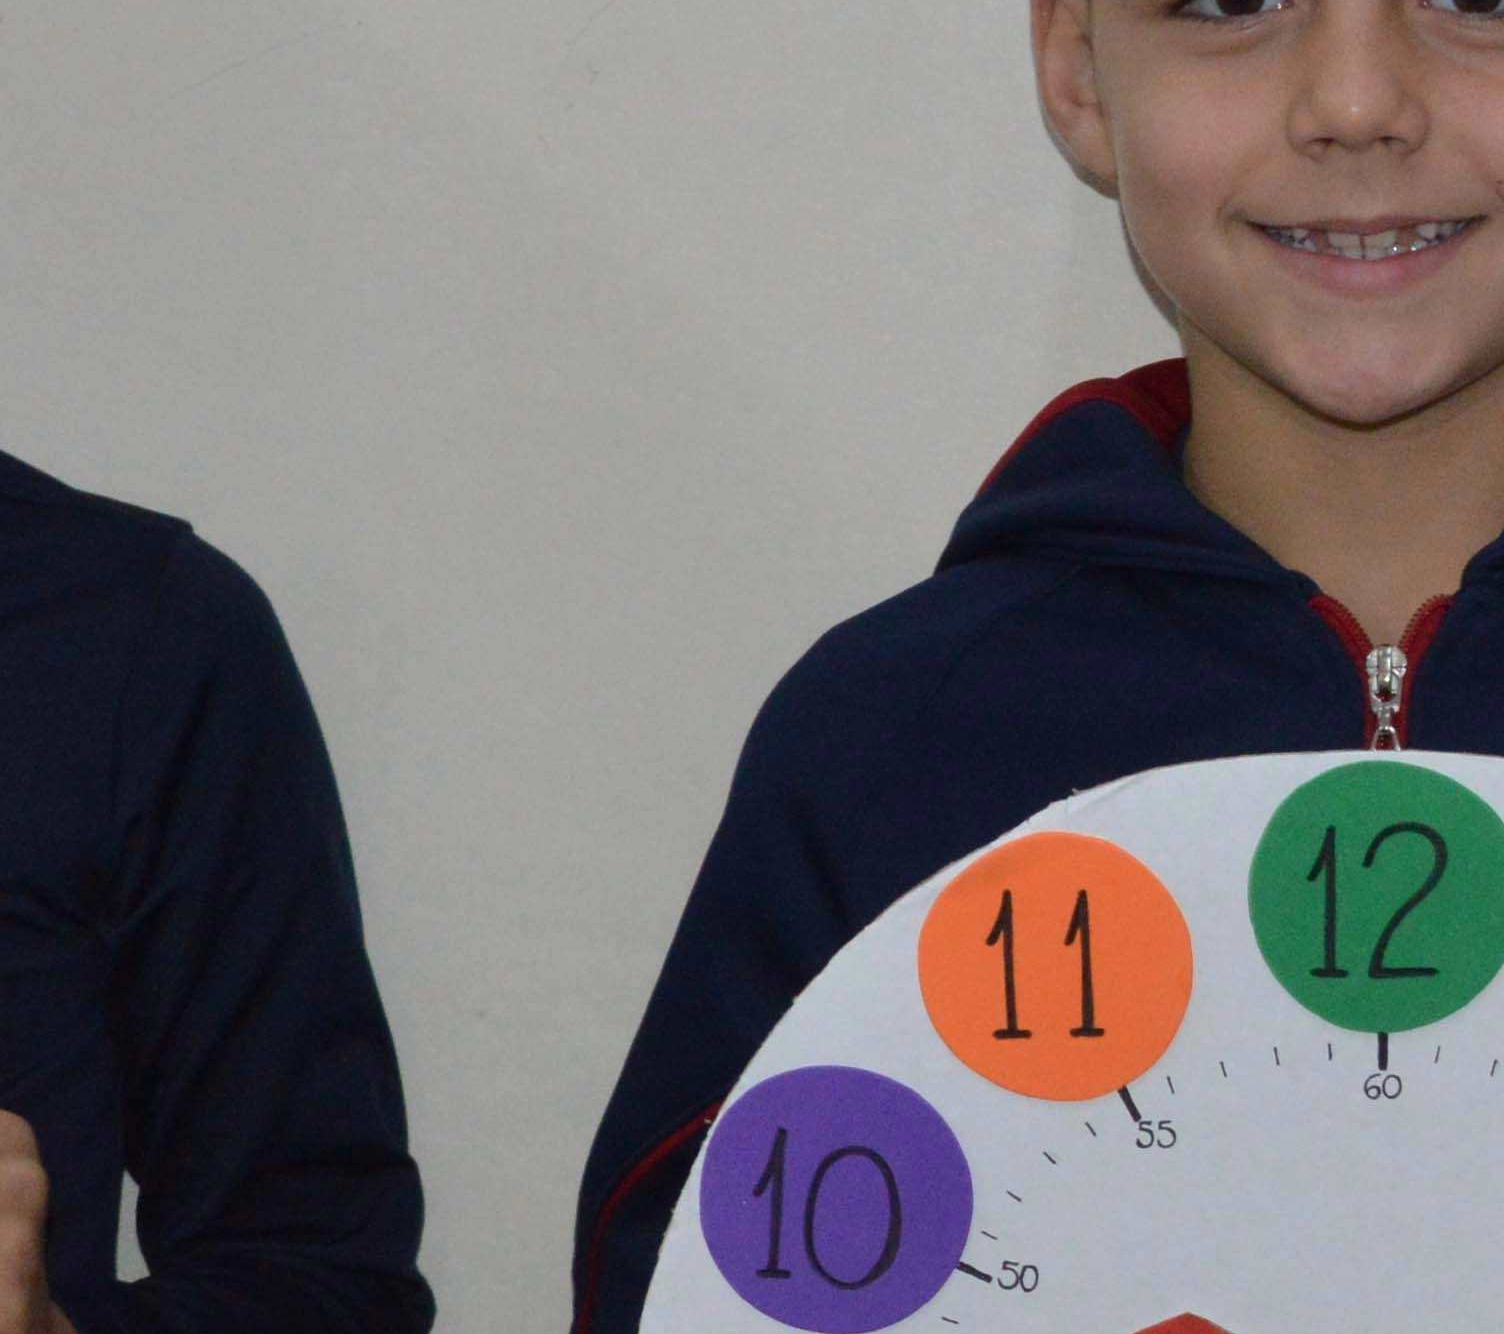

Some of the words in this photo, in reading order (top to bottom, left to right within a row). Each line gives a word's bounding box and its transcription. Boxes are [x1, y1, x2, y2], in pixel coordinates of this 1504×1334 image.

[1305, 821, 1447, 979] 12
[985, 889, 1105, 1040] 11
[1363, 1072, 1403, 1101] 60
[1136, 1120, 1177, 1150] 55
[753, 1127, 903, 1291] 10
[997, 1260, 1040, 1294] 50
